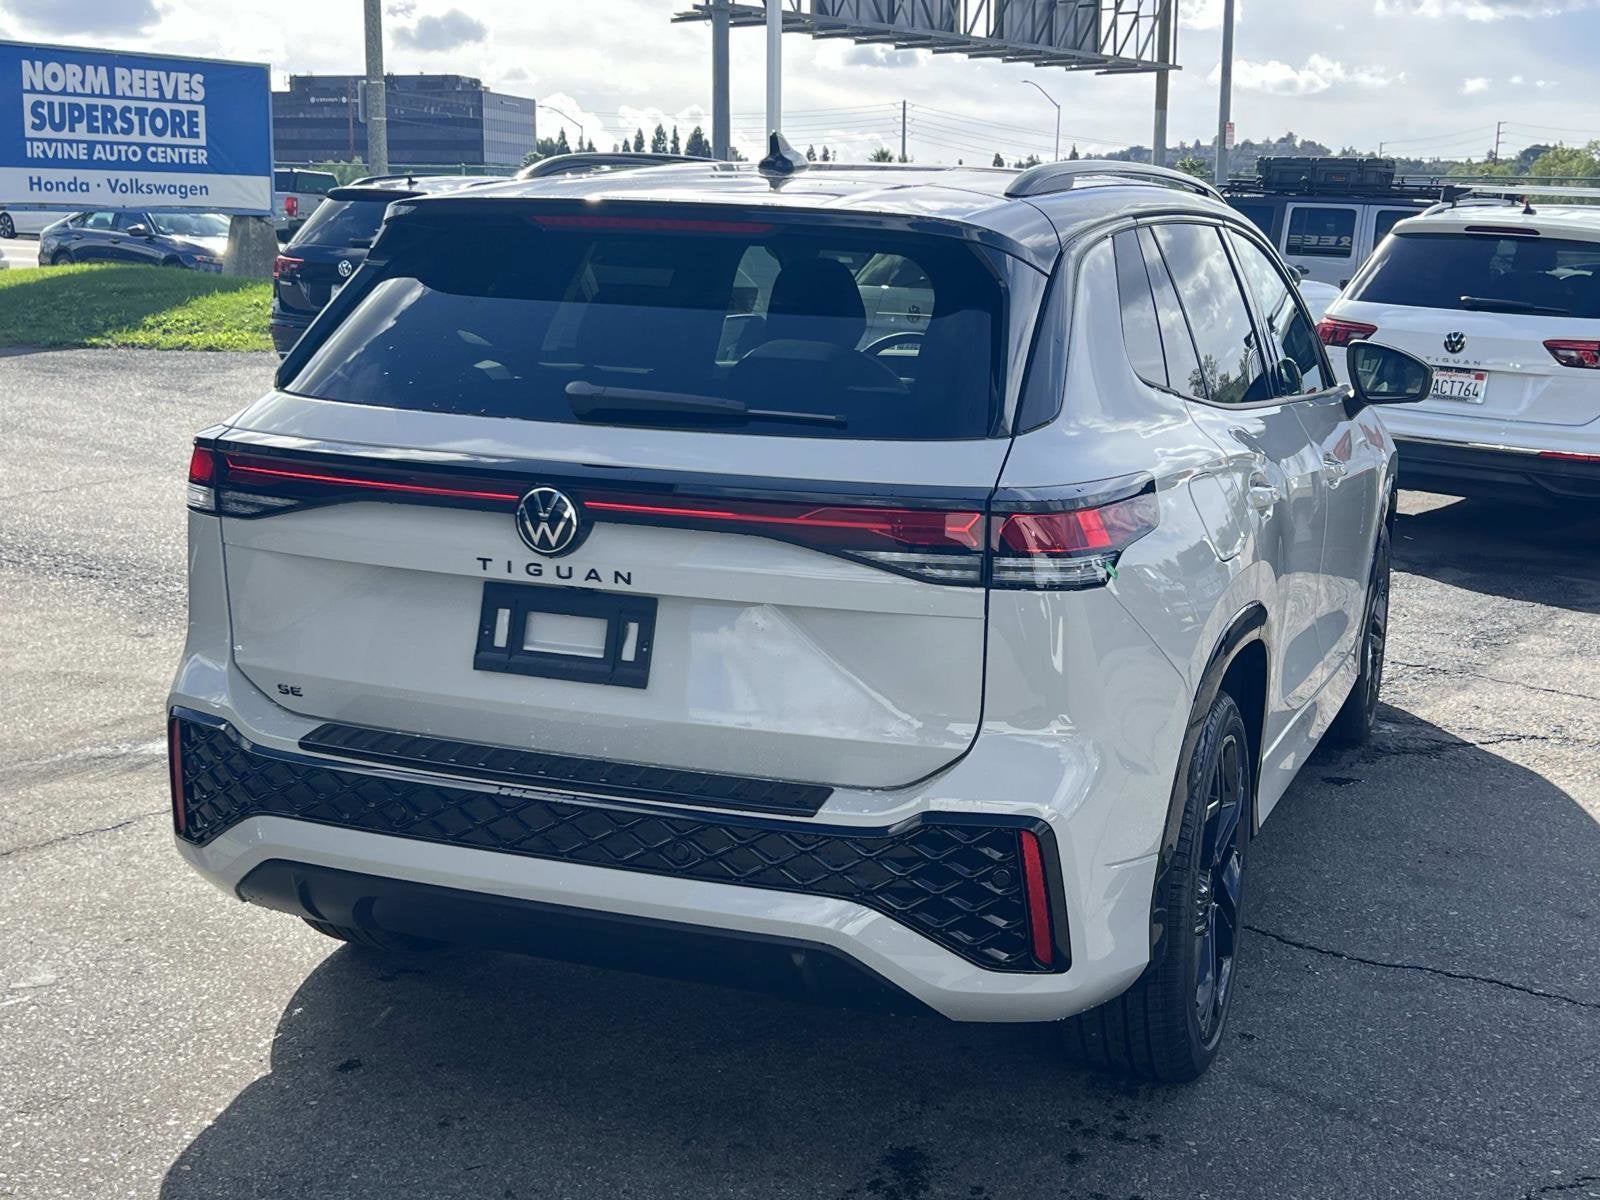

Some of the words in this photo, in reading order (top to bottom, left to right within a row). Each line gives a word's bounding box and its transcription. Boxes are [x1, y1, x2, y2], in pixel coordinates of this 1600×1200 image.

[21, 59, 110, 96] NORM
[115, 67, 206, 102] REEVES
[30, 99, 200, 140] SUPERSTORE
[26, 141, 88, 161] IRVINE
[93, 143, 142, 163] AUTO
[147, 146, 208, 165] CENTER
[28, 176, 90, 193] Honda
[107, 177, 209, 199] Volkswagen
[1425, 355, 1481, 366] TIGUAN
[1432, 379, 1479, 397] ACT764
[516, 487, 578, 553] VW
[476, 557, 633, 585] TIGUAN
[277, 683, 304, 697] SE
